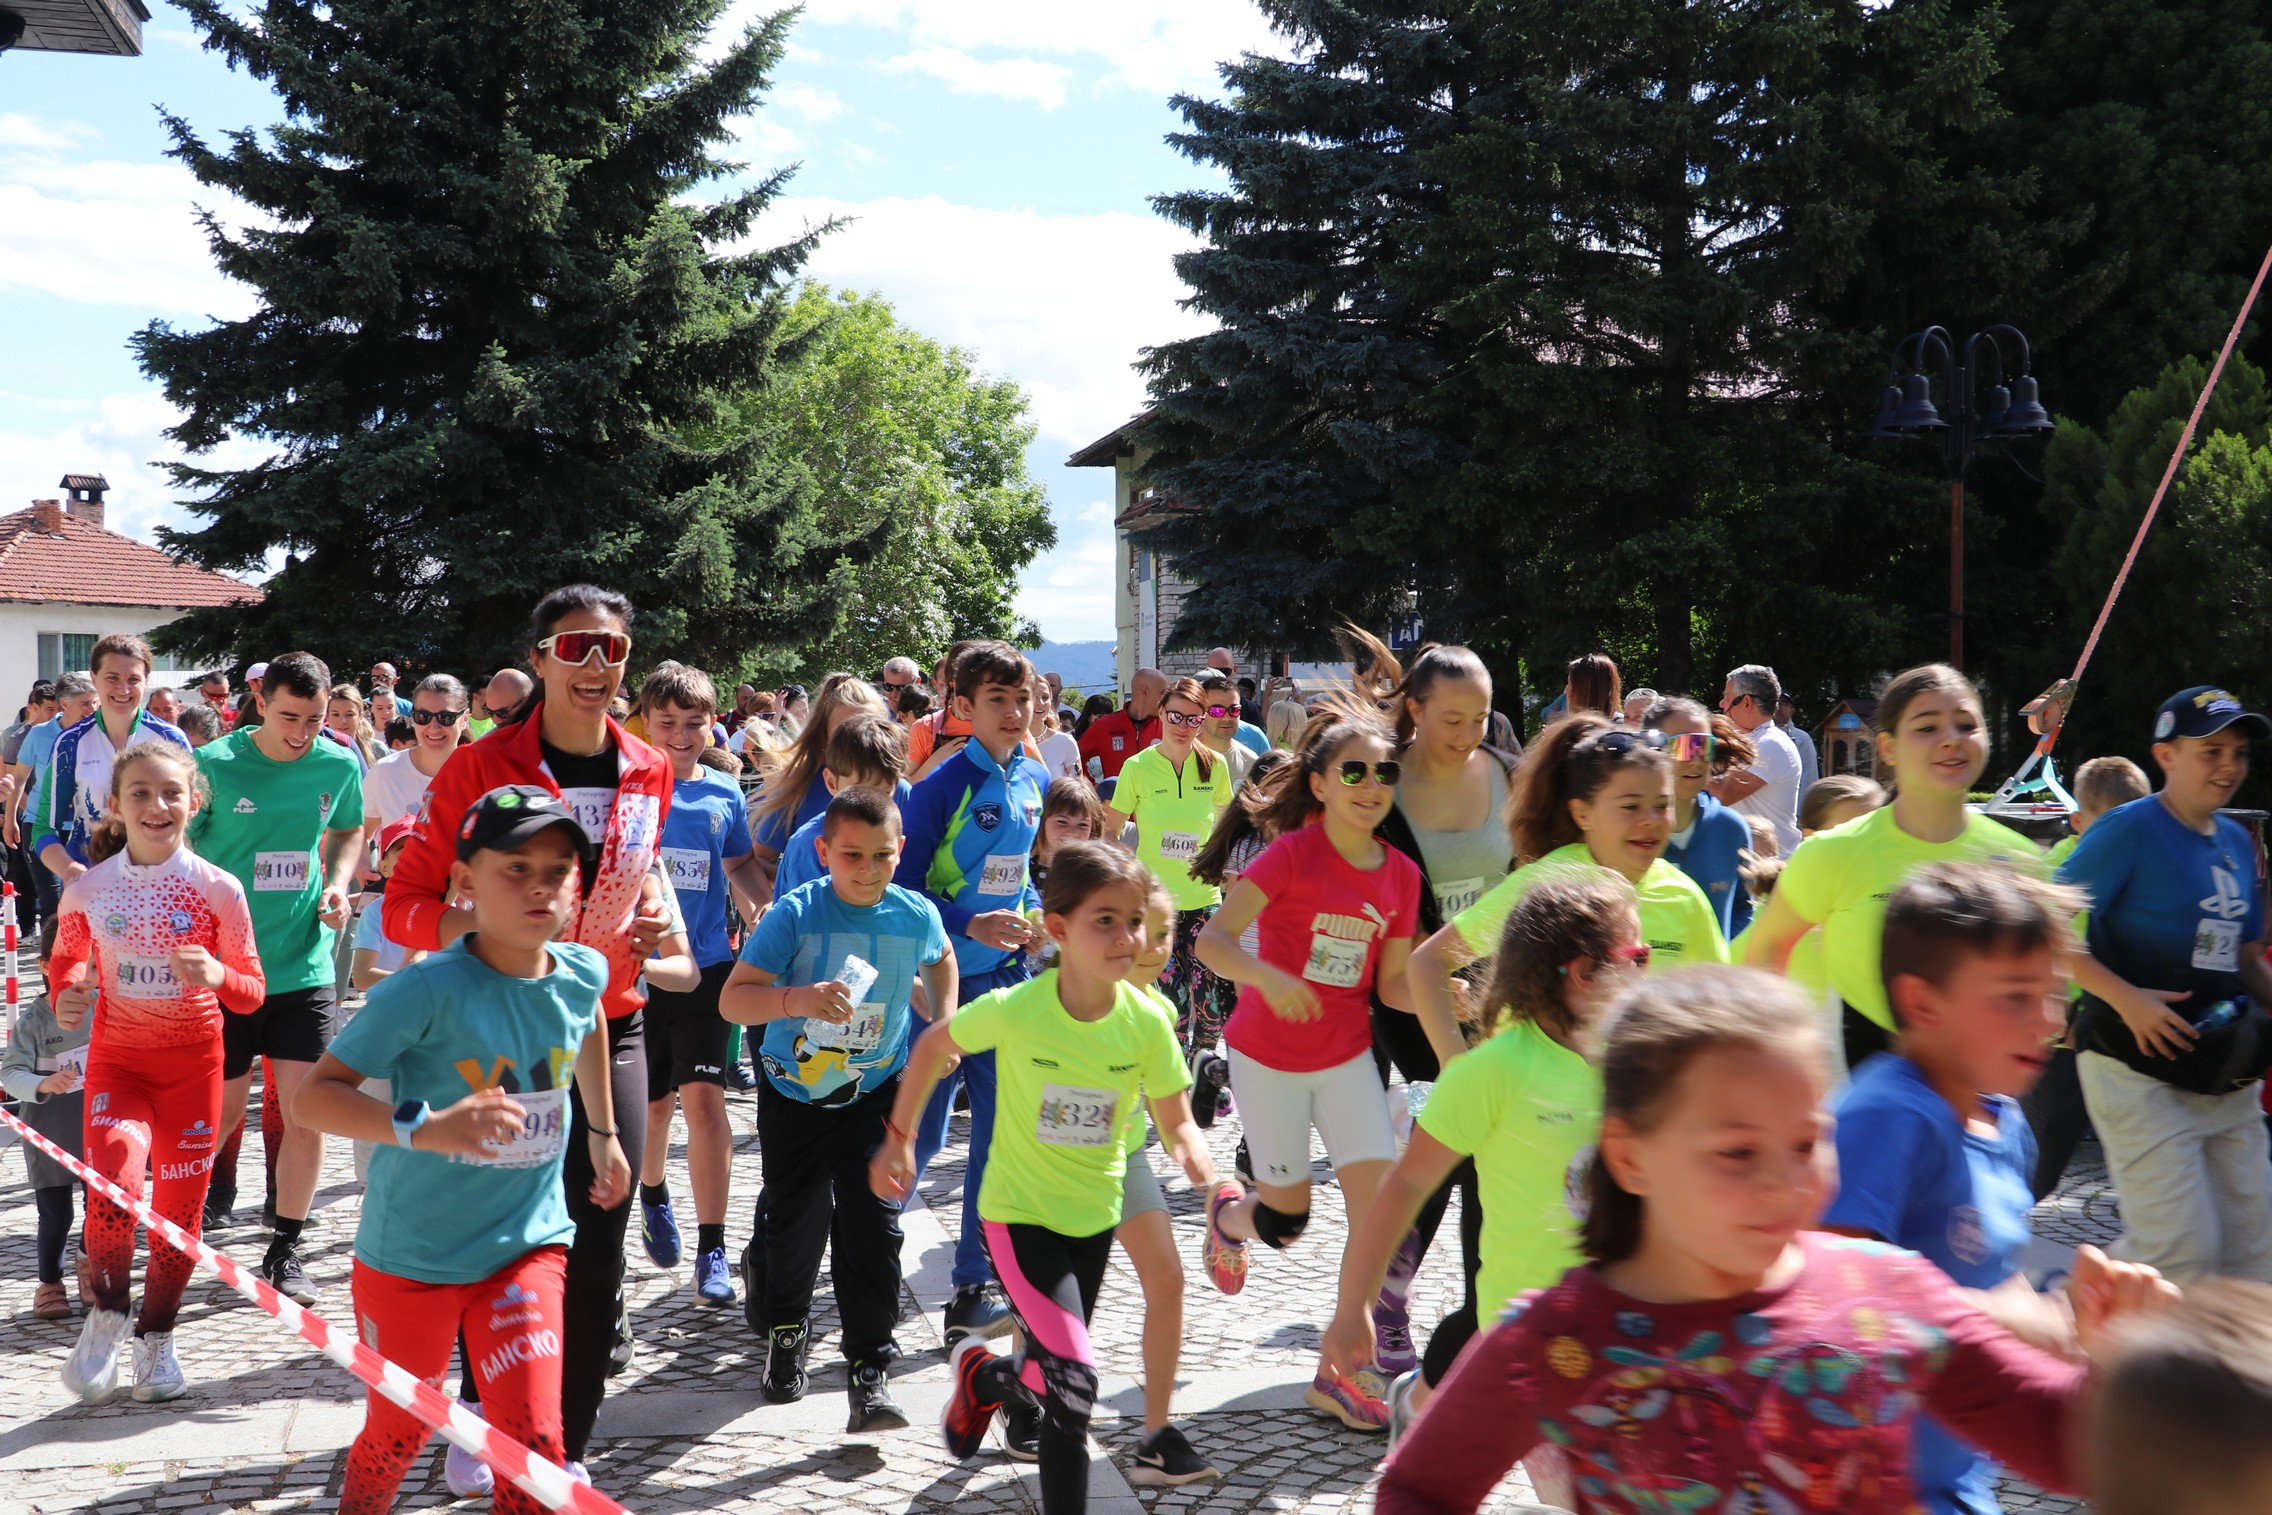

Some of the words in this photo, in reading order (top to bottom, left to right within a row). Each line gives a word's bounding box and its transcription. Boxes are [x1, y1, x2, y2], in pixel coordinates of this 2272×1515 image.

[1172, 839, 1190, 851] 60
[266, 863, 297, 878] 110
[675, 861, 698, 877] 85
[999, 866, 1018, 883] 92
[1310, 912, 1379, 943] PUMA
[127, 965, 172, 984] 105
[1062, 1102, 1100, 1127] 32
[91, 1115, 149, 1149] БИАТЛОН
[161, 1151, 216, 1180] БАНСКО
[480, 1328, 560, 1384] БАНСКО
